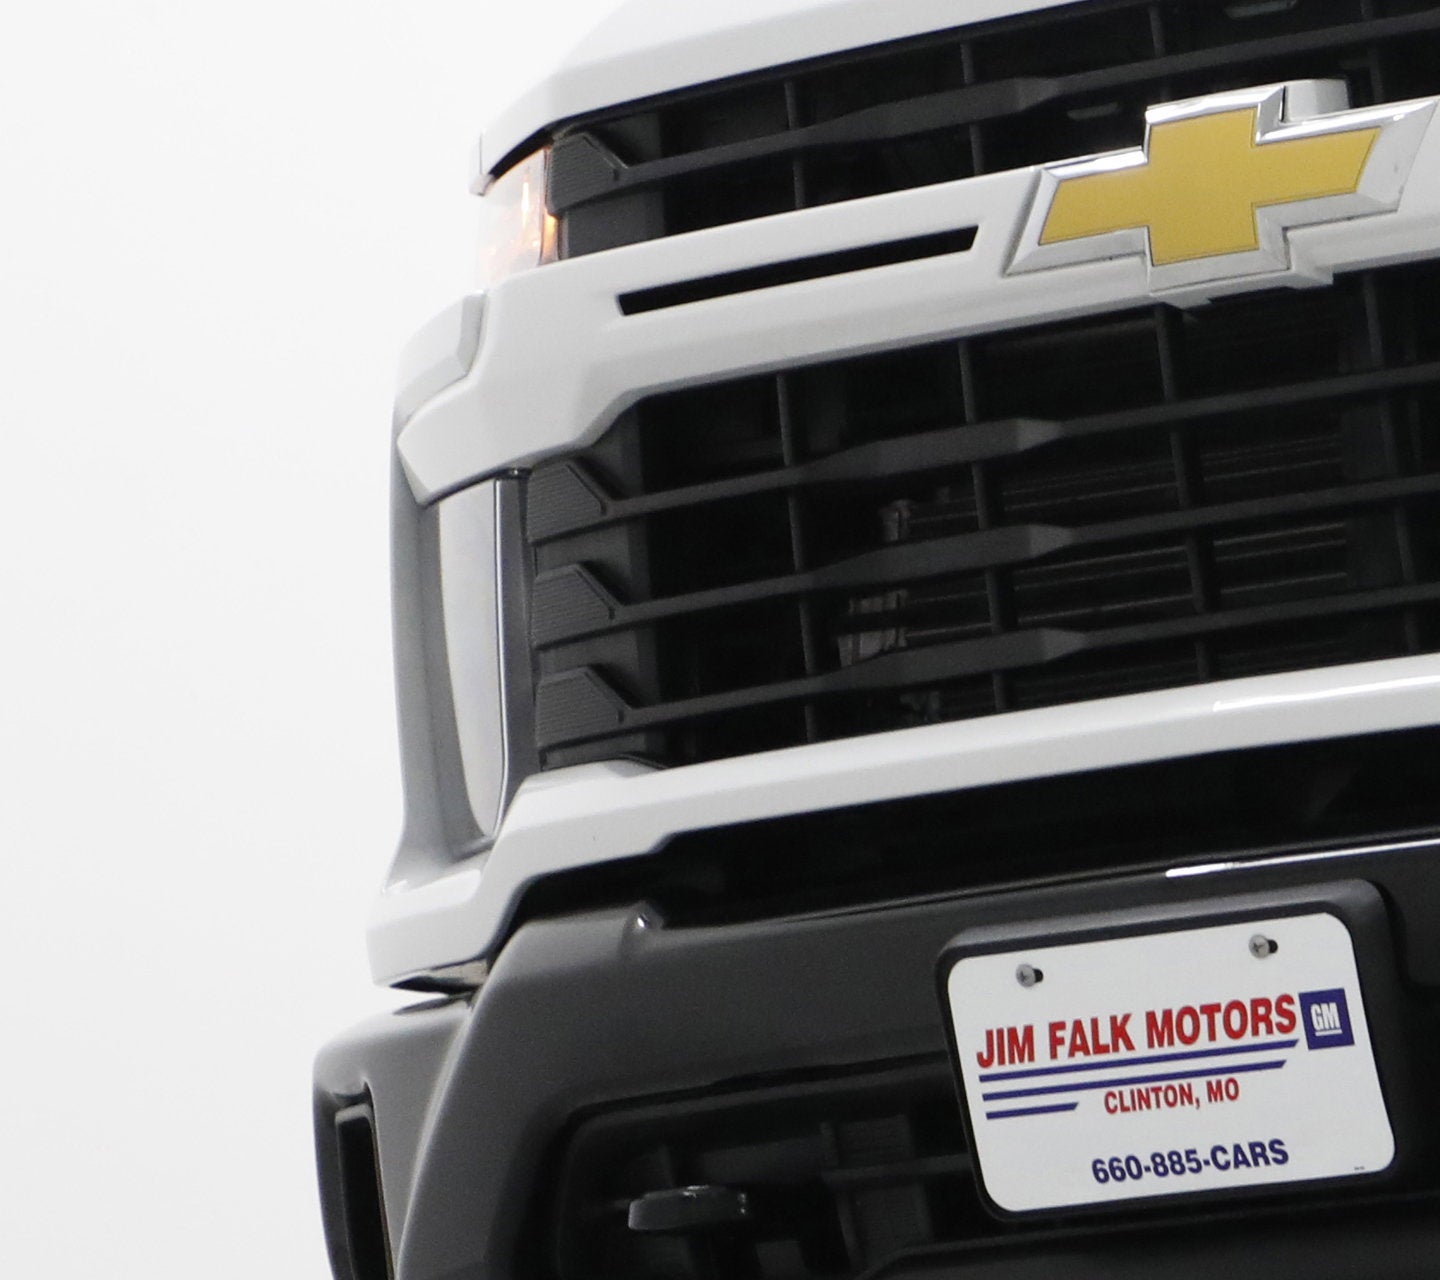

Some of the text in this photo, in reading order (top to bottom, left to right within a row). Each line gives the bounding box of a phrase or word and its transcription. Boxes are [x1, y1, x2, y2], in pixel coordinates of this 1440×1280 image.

[976, 993, 1298, 1069] JIM FALK MOTORS
[1310, 1001, 1342, 1037] GM
[1103, 1076, 1241, 1115] CLINTON, MO
[1090, 1137, 1290, 1185] 660-885-CARS
